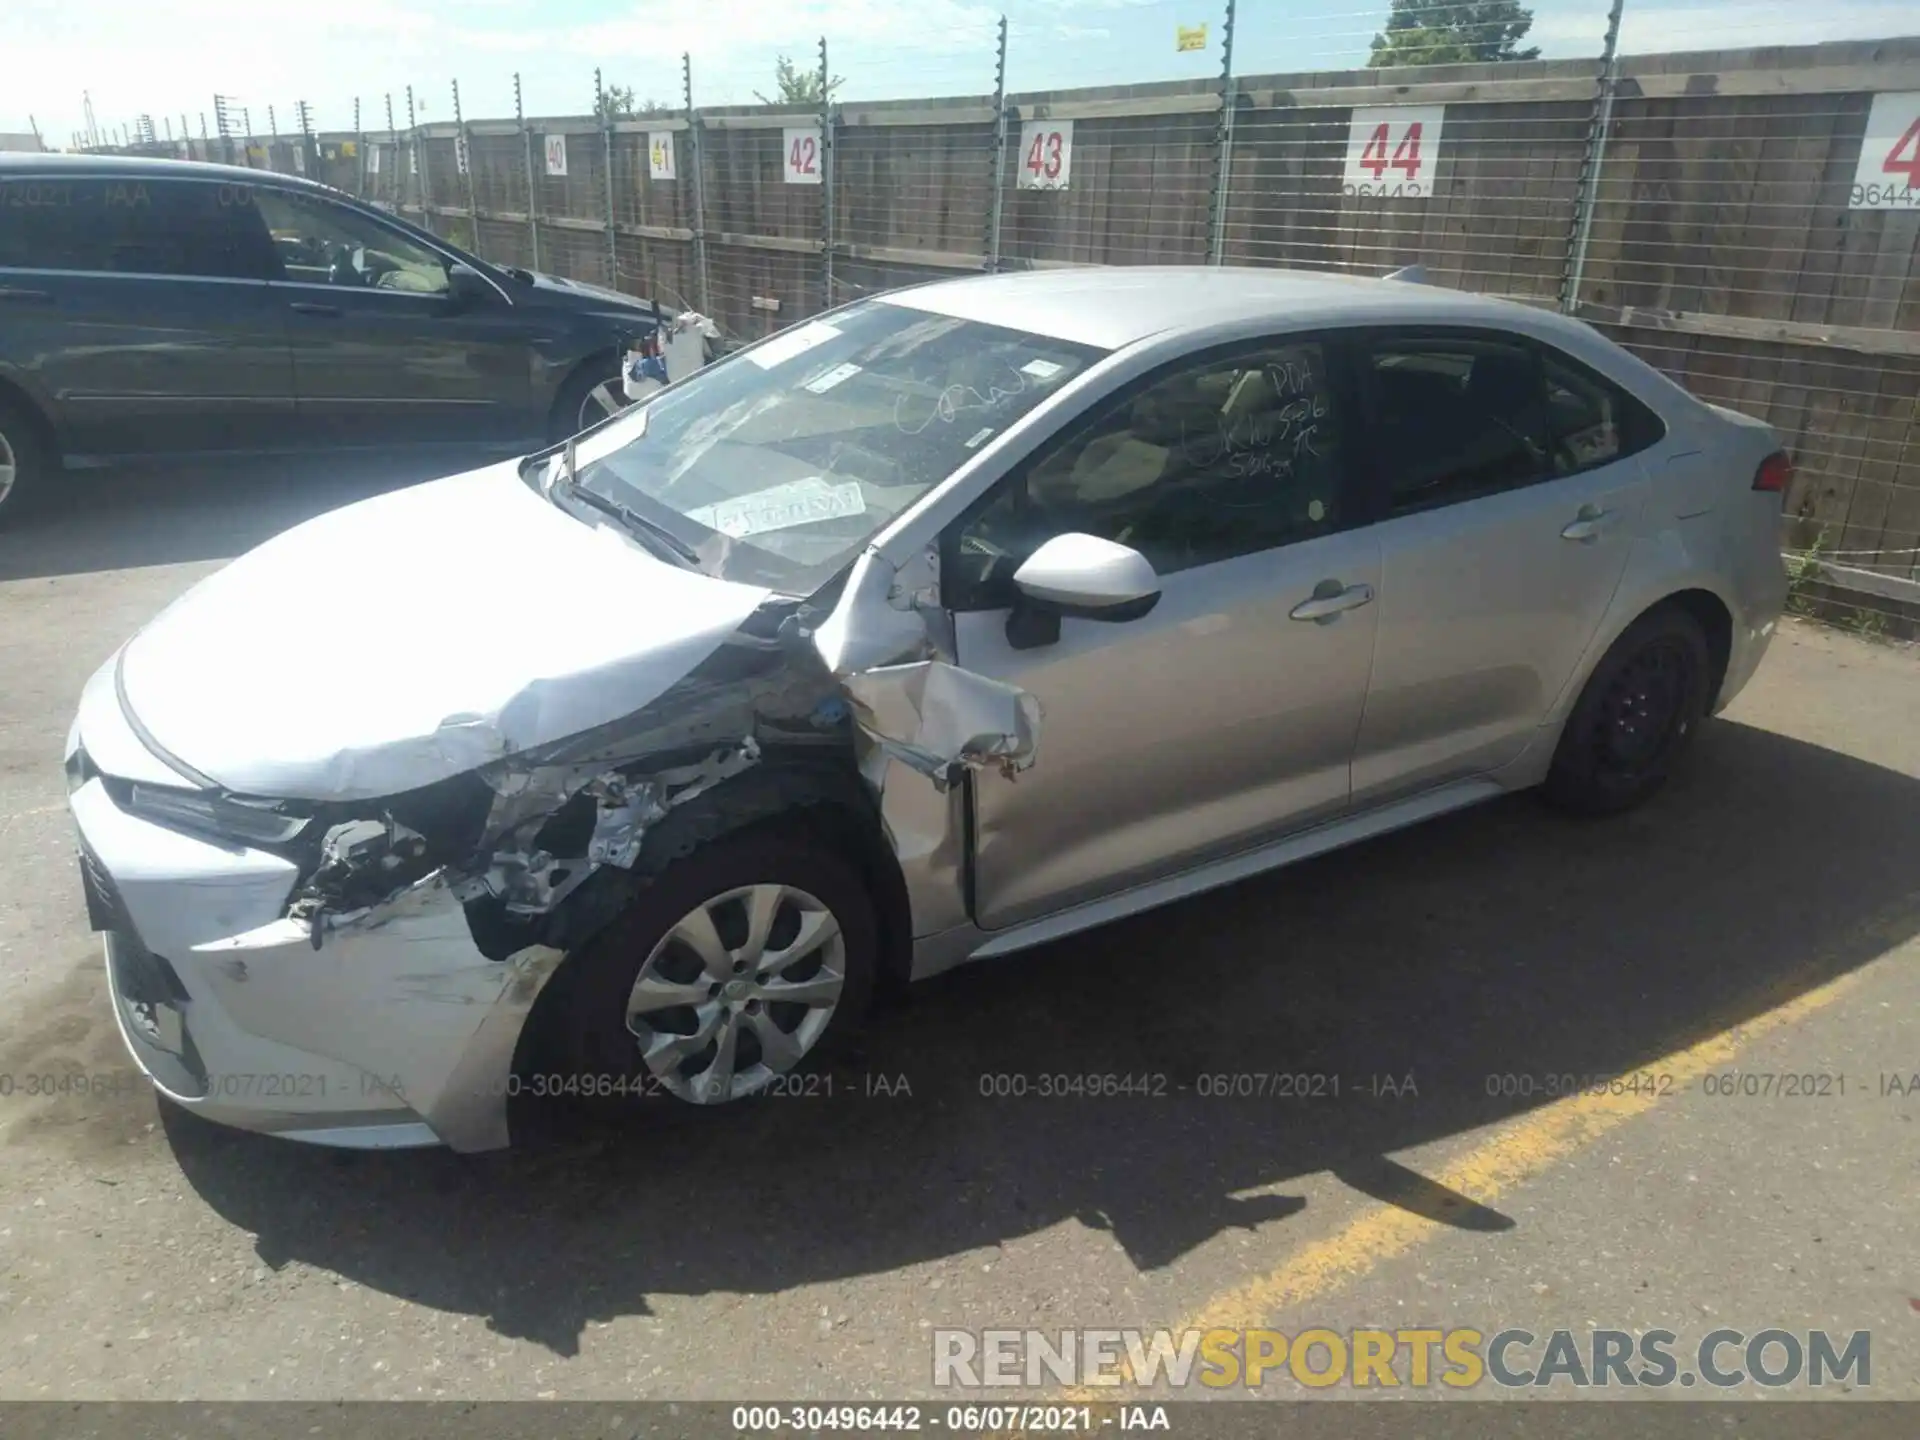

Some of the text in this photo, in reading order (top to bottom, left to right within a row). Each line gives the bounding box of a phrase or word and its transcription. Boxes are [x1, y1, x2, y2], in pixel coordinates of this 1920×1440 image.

[548, 140, 563, 169] 40
[789, 137, 815, 174] 42
[1027, 132, 1062, 178] 43
[1358, 122, 1422, 180] 44
